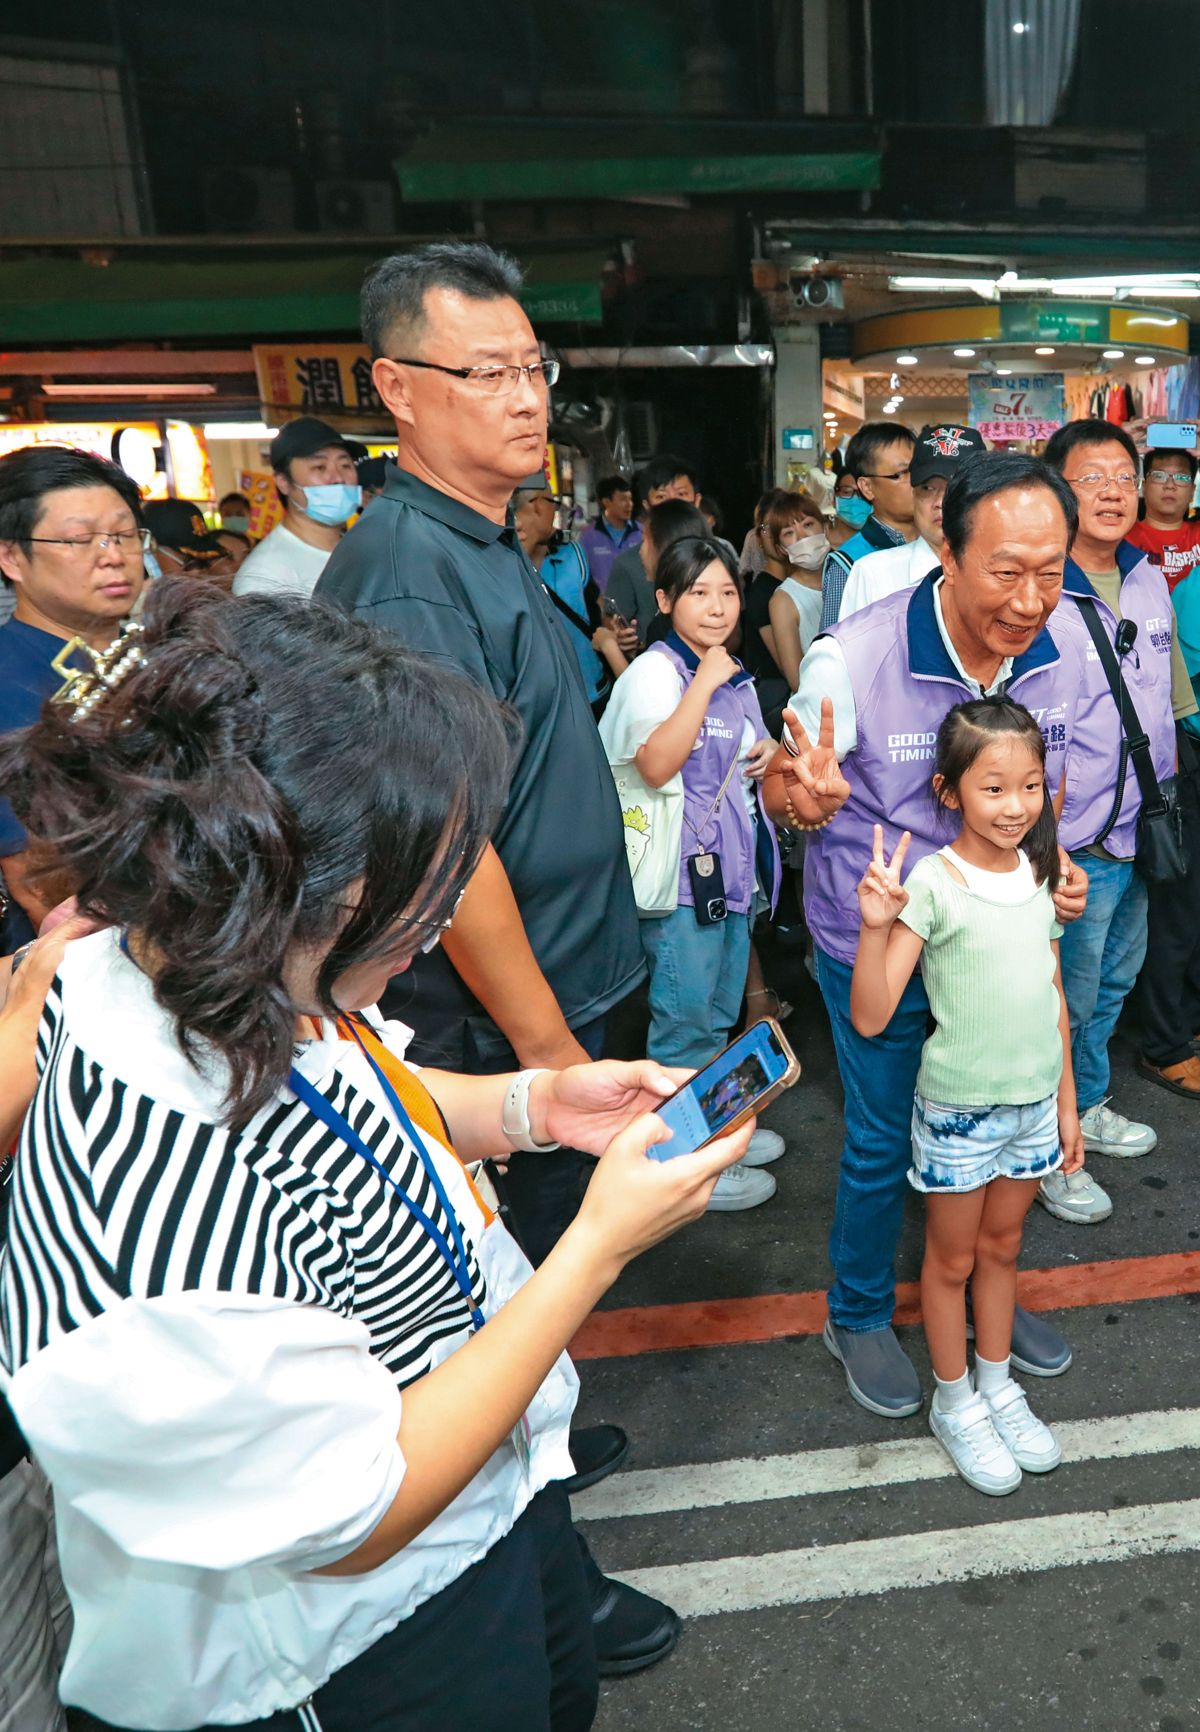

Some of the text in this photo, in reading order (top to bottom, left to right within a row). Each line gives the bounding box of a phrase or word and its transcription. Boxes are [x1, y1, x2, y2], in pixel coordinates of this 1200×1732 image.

[1010, 392, 1027, 416] 7
[1146, 618, 1161, 632] GT
[888, 732, 937, 748] GOOD
[889, 747, 937, 763] TiMIN
